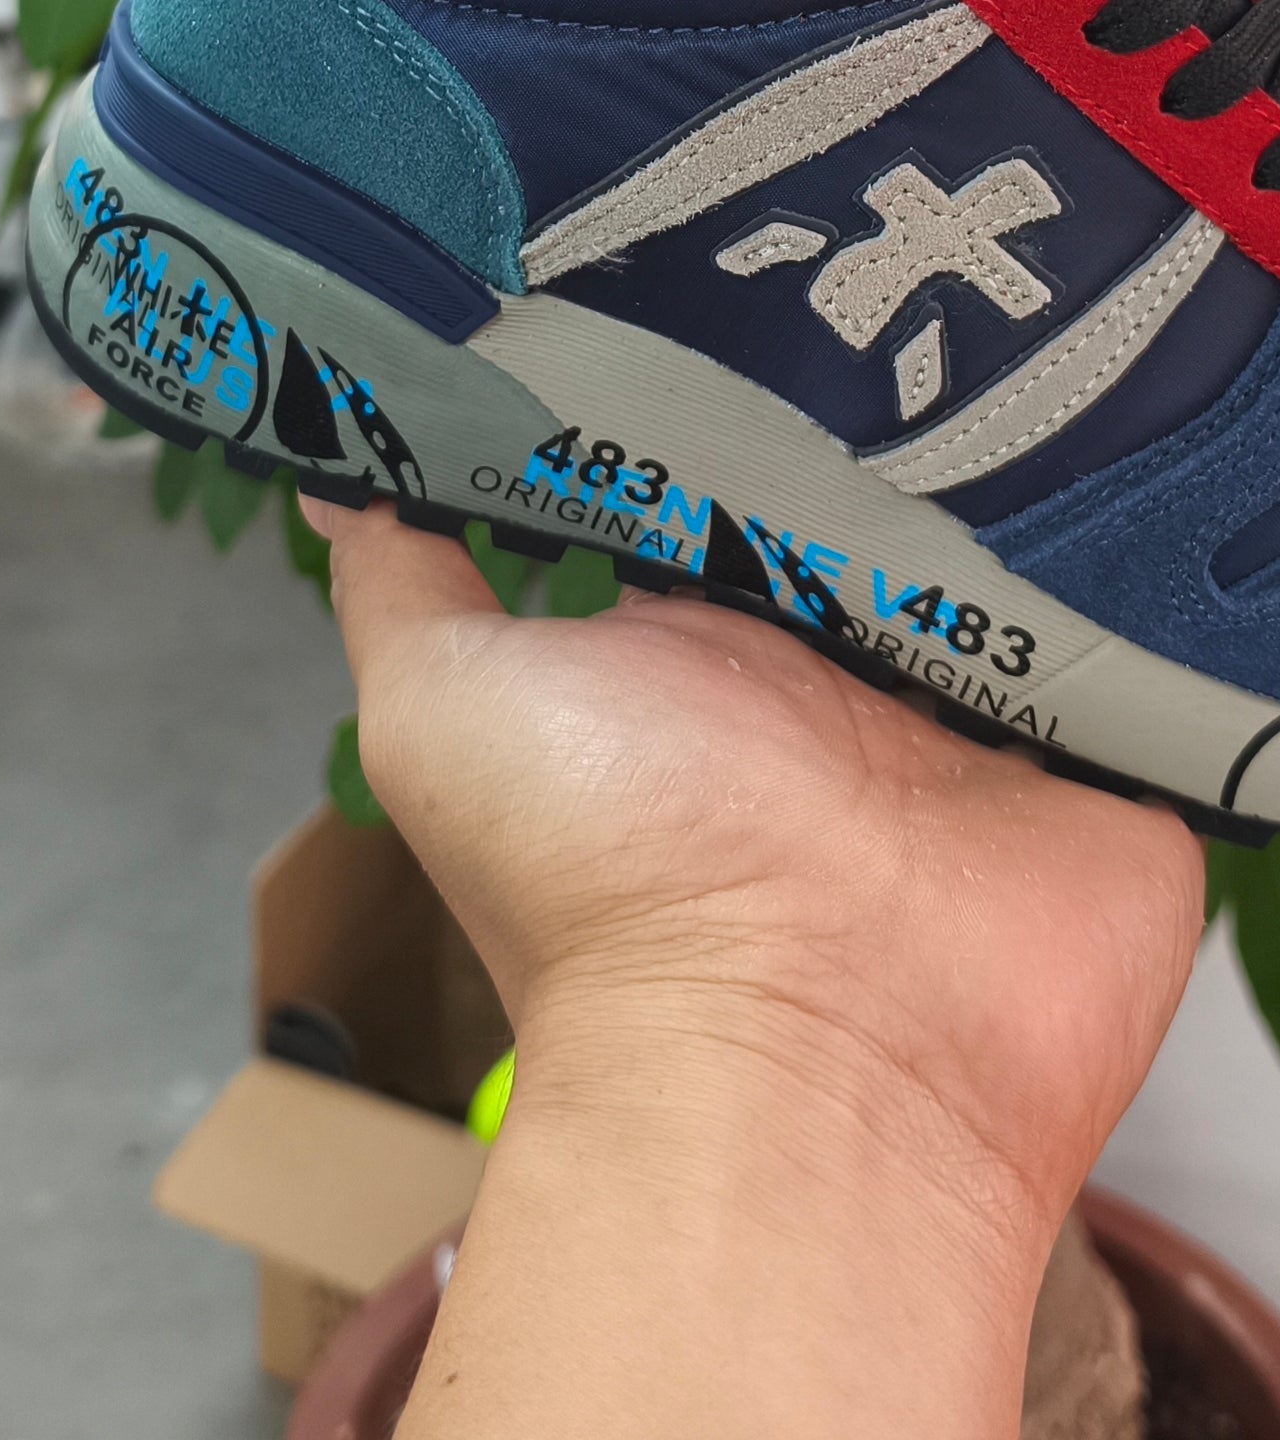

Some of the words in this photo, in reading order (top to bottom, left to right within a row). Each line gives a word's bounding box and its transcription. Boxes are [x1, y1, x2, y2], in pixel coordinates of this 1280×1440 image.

[79, 167, 149, 259] 483
[88, 324, 206, 417] FORCE
[109, 309, 192, 381] AIR
[534, 426, 669, 505] 483
[470, 465, 691, 568] ORIGINAL
[899, 584, 1036, 677] 483
[841, 615, 1067, 748] ORIGINAL
